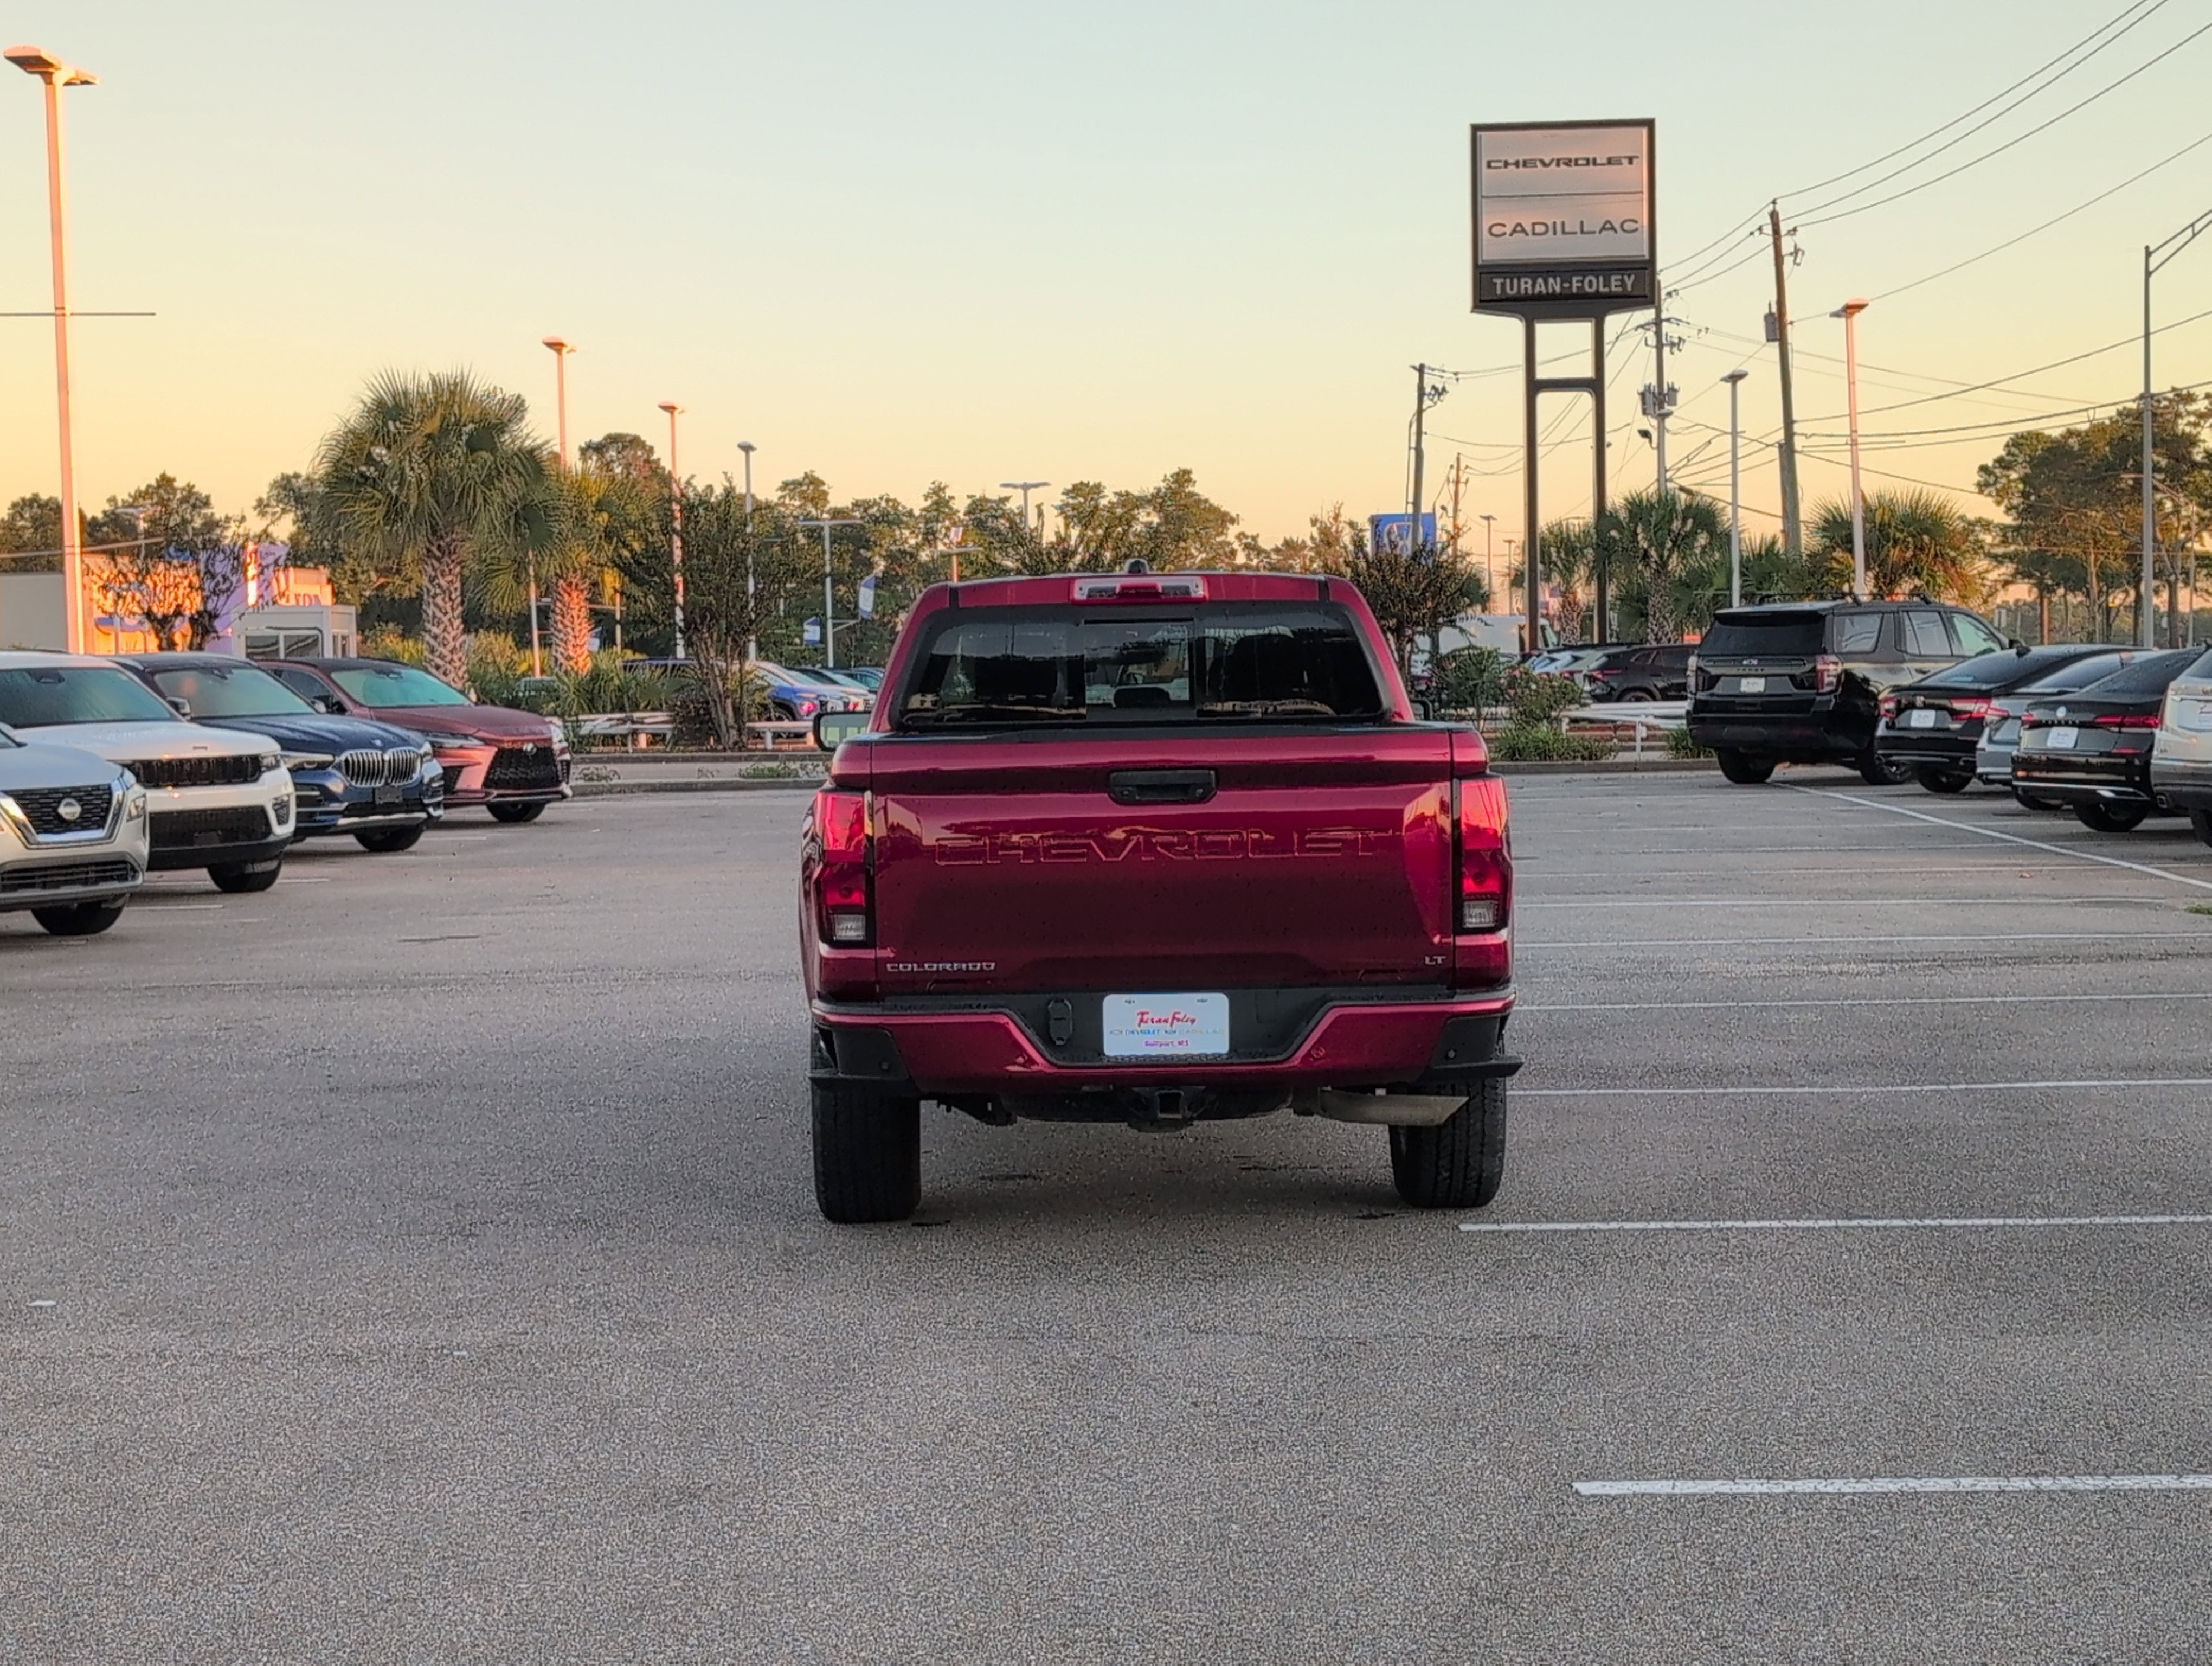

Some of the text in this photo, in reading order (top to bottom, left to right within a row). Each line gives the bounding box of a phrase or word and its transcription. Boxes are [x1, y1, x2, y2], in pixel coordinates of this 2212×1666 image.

[1486, 156, 1639, 170] CHEVROLET
[1488, 219, 1639, 238] CADILLAC
[1492, 274, 1636, 296] TURAN-FOLEY
[935, 828, 1392, 865] CHEVROLET
[886, 962, 995, 972] COLORADO
[1424, 956, 1446, 965] LT
